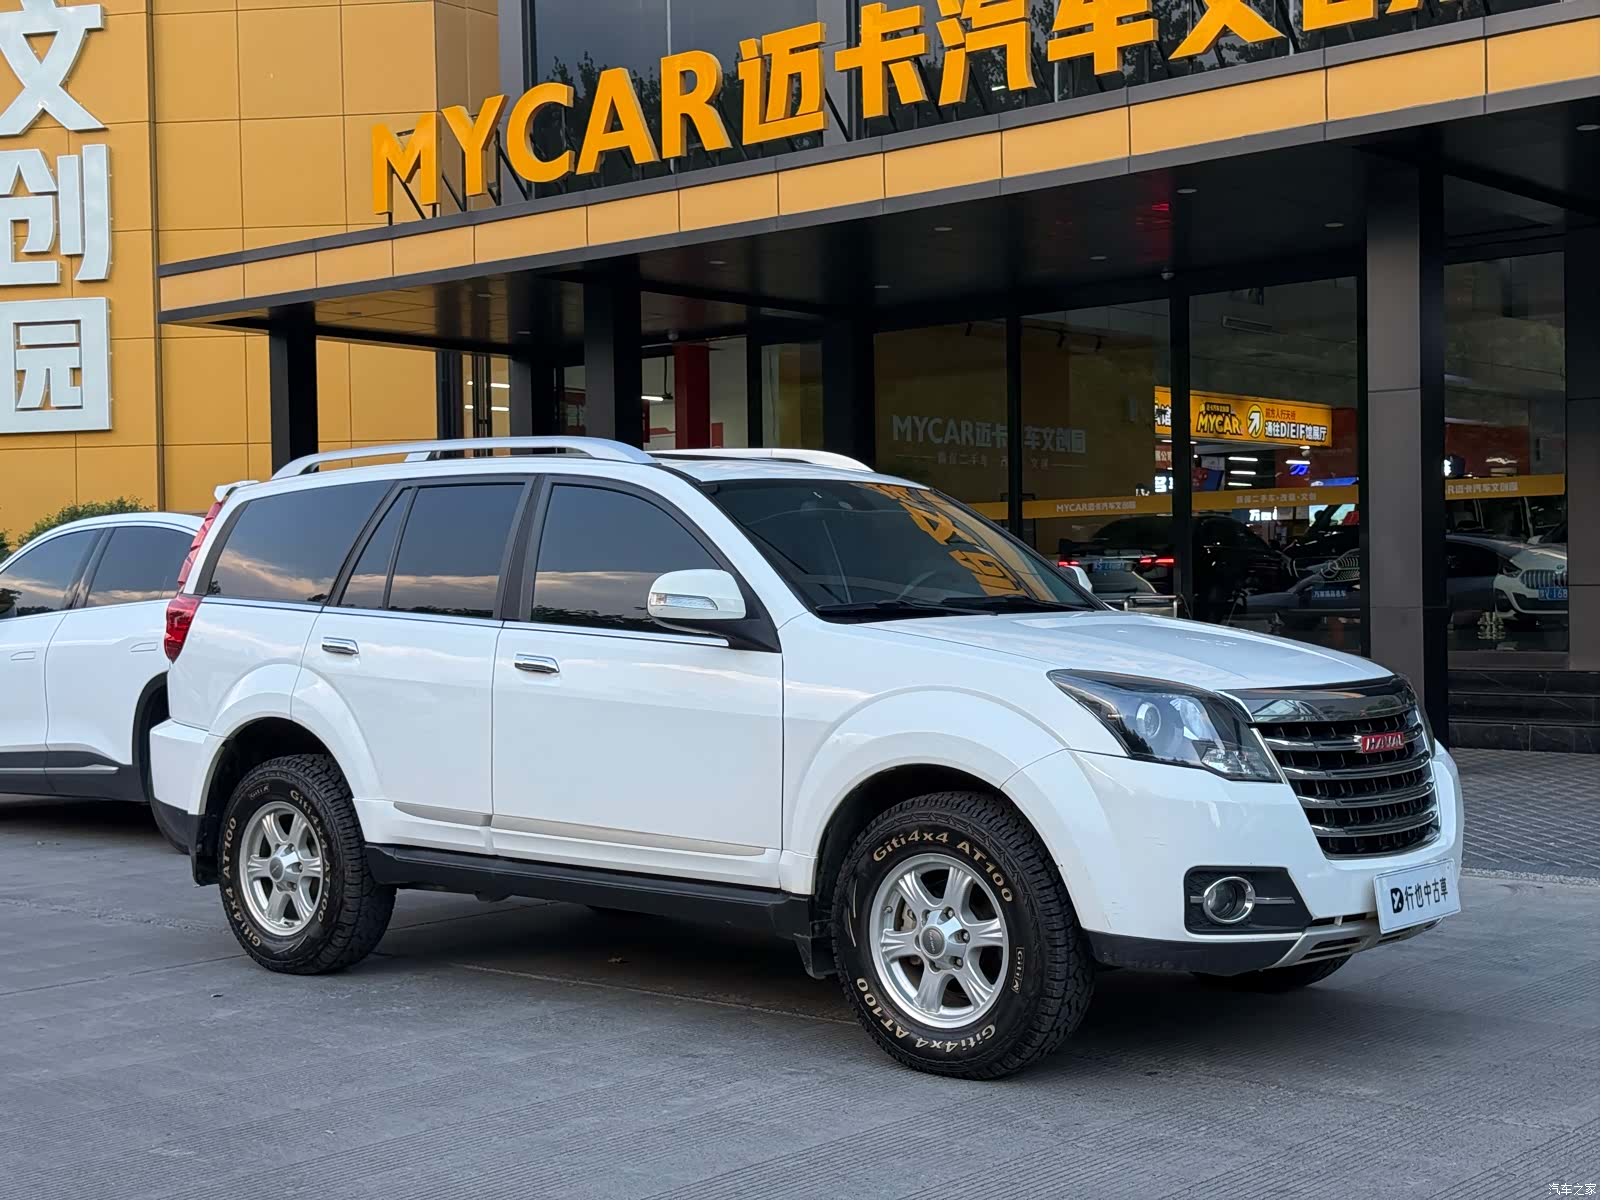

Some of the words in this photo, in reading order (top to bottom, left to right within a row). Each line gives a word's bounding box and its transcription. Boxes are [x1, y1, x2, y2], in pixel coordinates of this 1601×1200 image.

[0, 0, 112, 434] 文创园
[892, 415, 1086, 453] MYCAR迈卡车文创园
[1197, 412, 1242, 435] MYCAR
[956, 840, 1013, 902] AT100
[856, 977, 910, 1039] AT100
